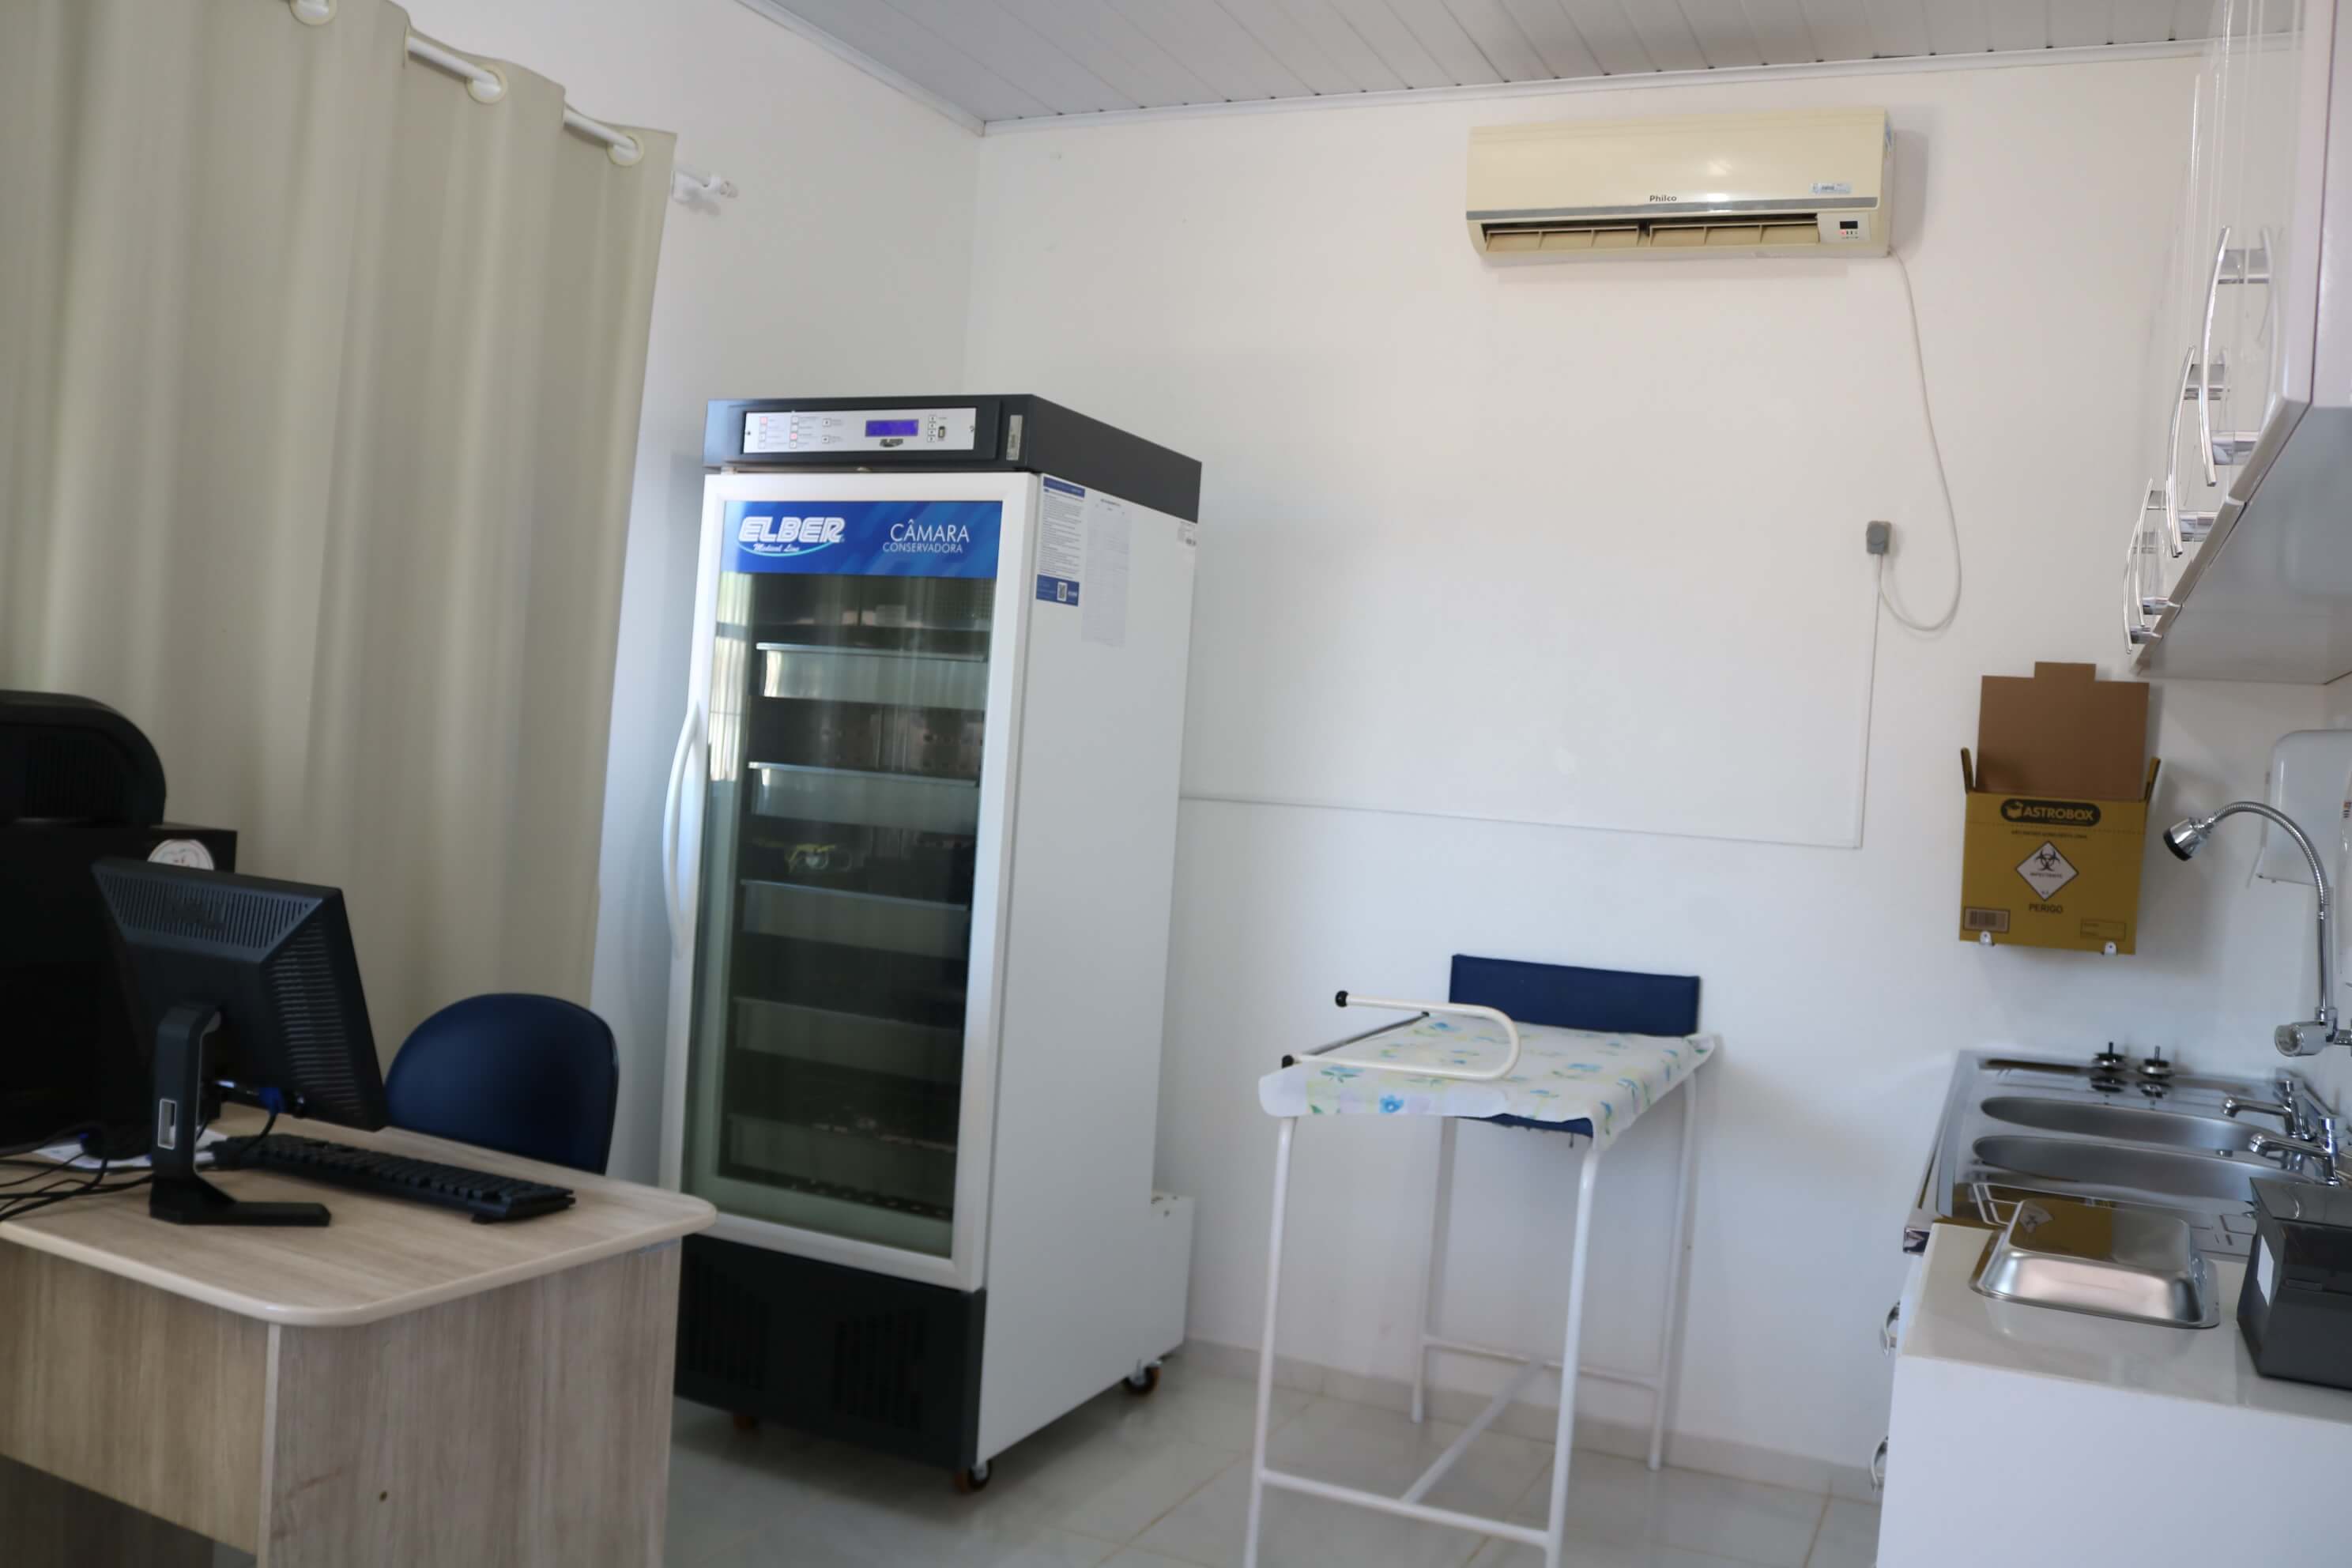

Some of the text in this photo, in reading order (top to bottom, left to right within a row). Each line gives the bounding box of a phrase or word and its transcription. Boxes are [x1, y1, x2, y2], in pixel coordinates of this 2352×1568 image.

[738, 516, 846, 543] ELBER
[890, 518, 970, 543] CÂMARA
[882, 542, 963, 553] CONSERVADORA
[2023, 806, 2094, 820] ASTROBOX
[2029, 903, 2064, 914] PERIGO
